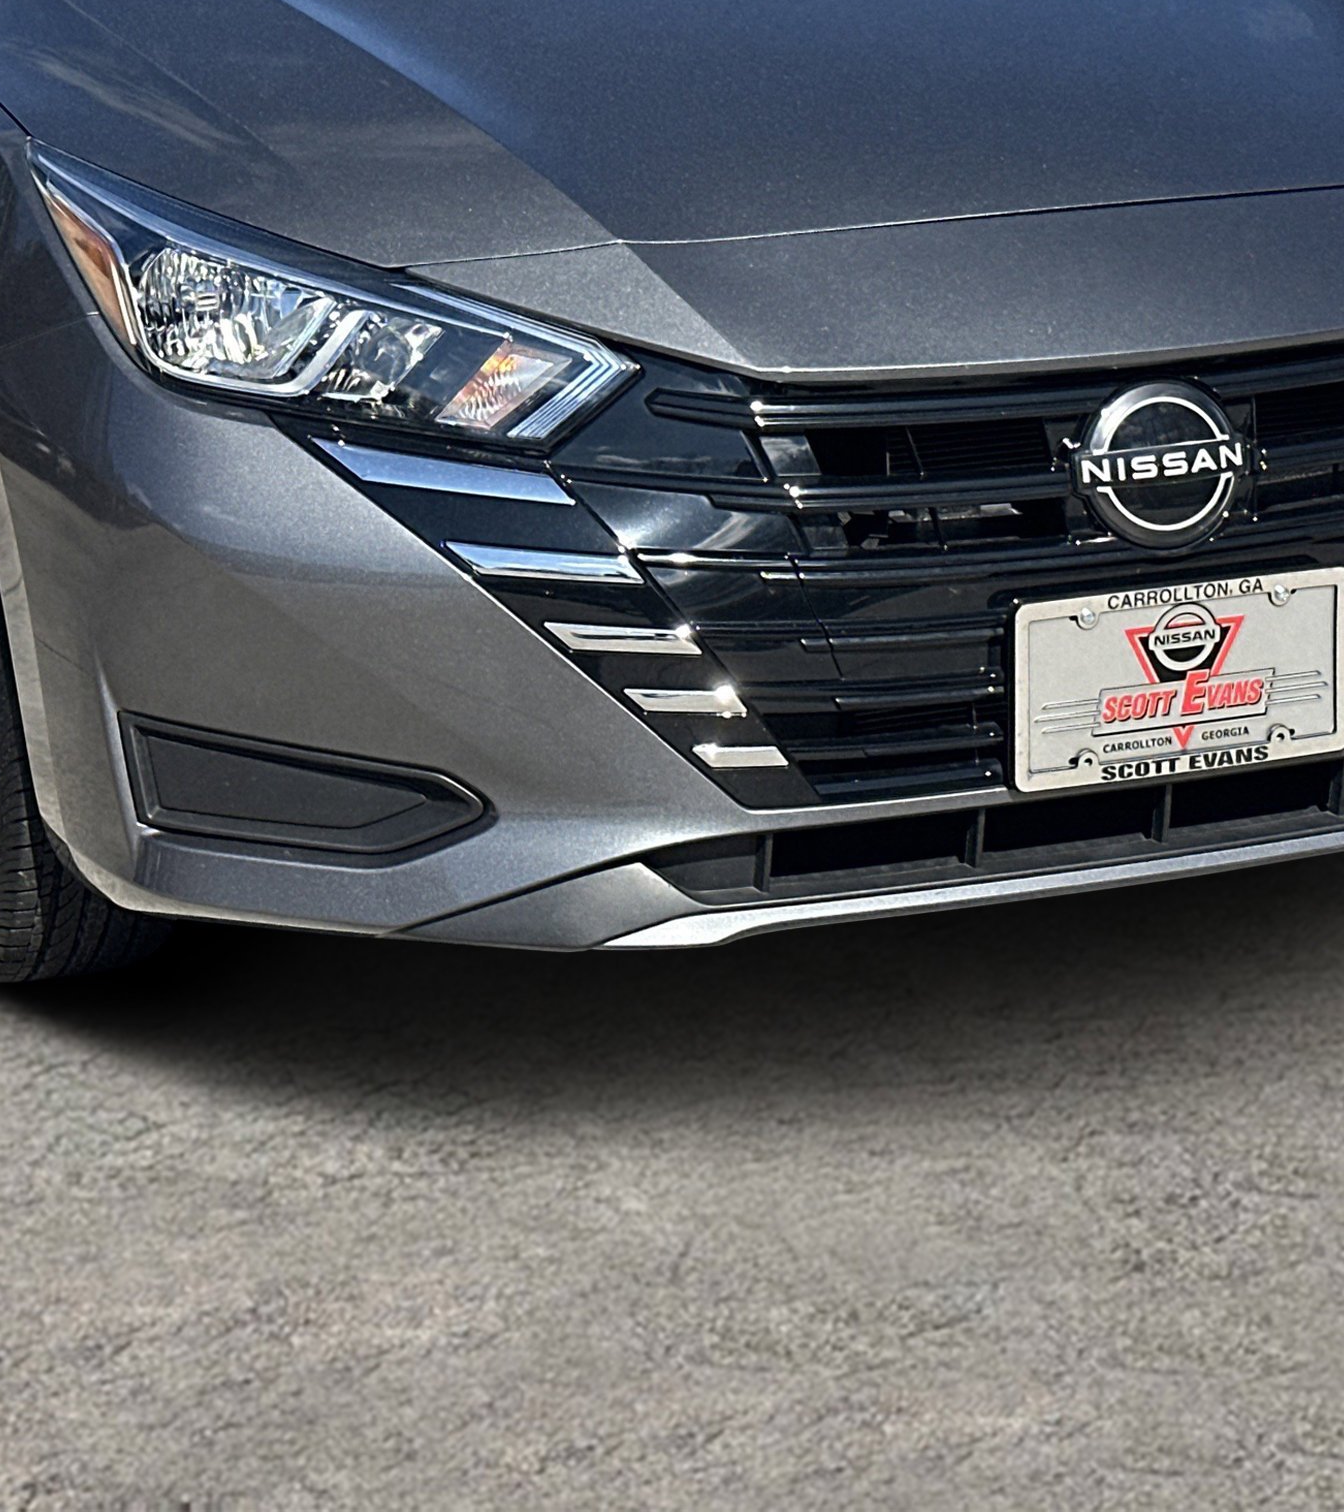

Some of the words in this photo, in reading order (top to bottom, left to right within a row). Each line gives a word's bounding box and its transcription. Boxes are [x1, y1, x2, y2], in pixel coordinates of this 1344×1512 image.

[1081, 442, 1244, 484] NISSAN
[1239, 578, 1264, 595] GA
[1154, 629, 1216, 646] NISSAN
[1102, 689, 1177, 723] SCOTT
[1180, 669, 1265, 717] EVANS
[1201, 726, 1250, 741] GEORGIA
[1102, 736, 1172, 754] CARROLLTON
[1101, 757, 1181, 781] SCOTT
[1189, 745, 1269, 770] EVANS
